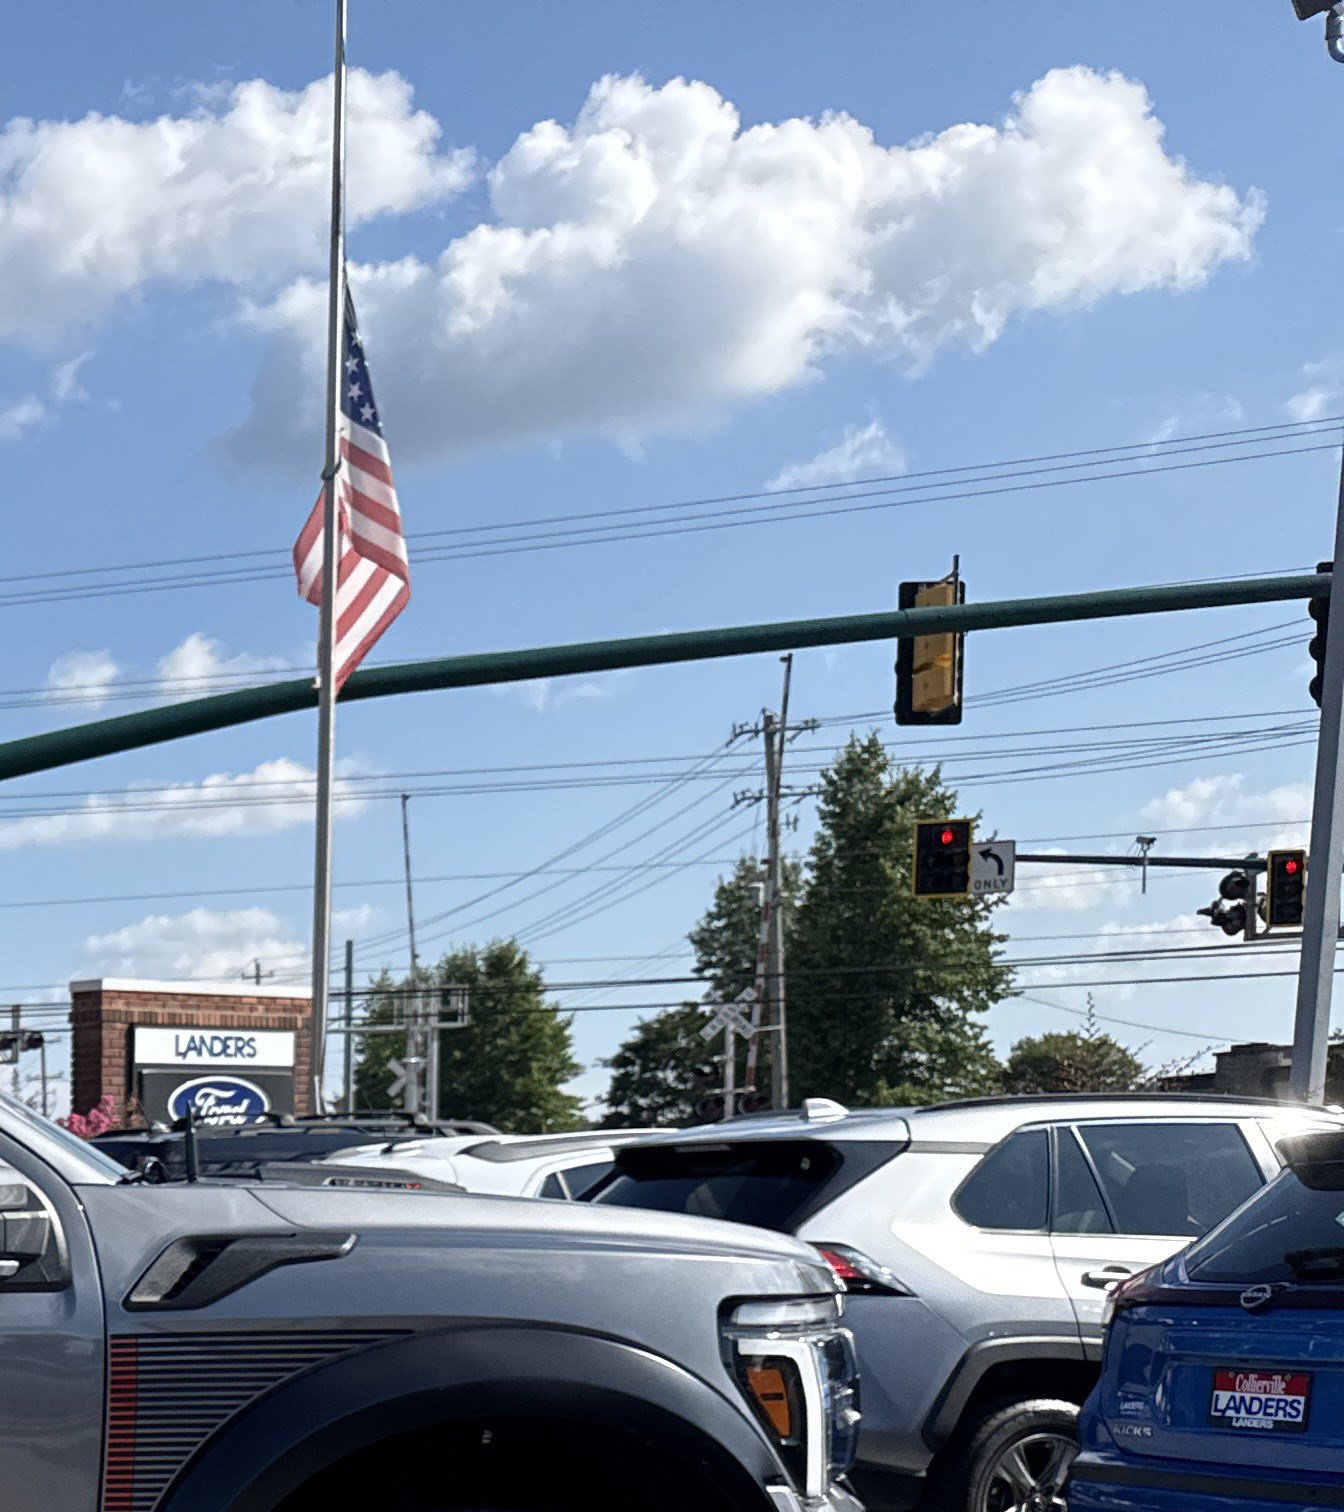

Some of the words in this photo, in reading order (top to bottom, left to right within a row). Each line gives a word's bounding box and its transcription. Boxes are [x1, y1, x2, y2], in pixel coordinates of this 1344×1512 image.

[974, 878, 1007, 890] ONLY
[174, 1034, 257, 1060] LANDERS
[193, 1087, 251, 1126] Ford
[1235, 1373, 1287, 1395] Collierville
[1213, 1393, 1302, 1419] LANDERS
[1113, 1424, 1152, 1437] KICKS
[1232, 1417, 1274, 1430] LANDERS
